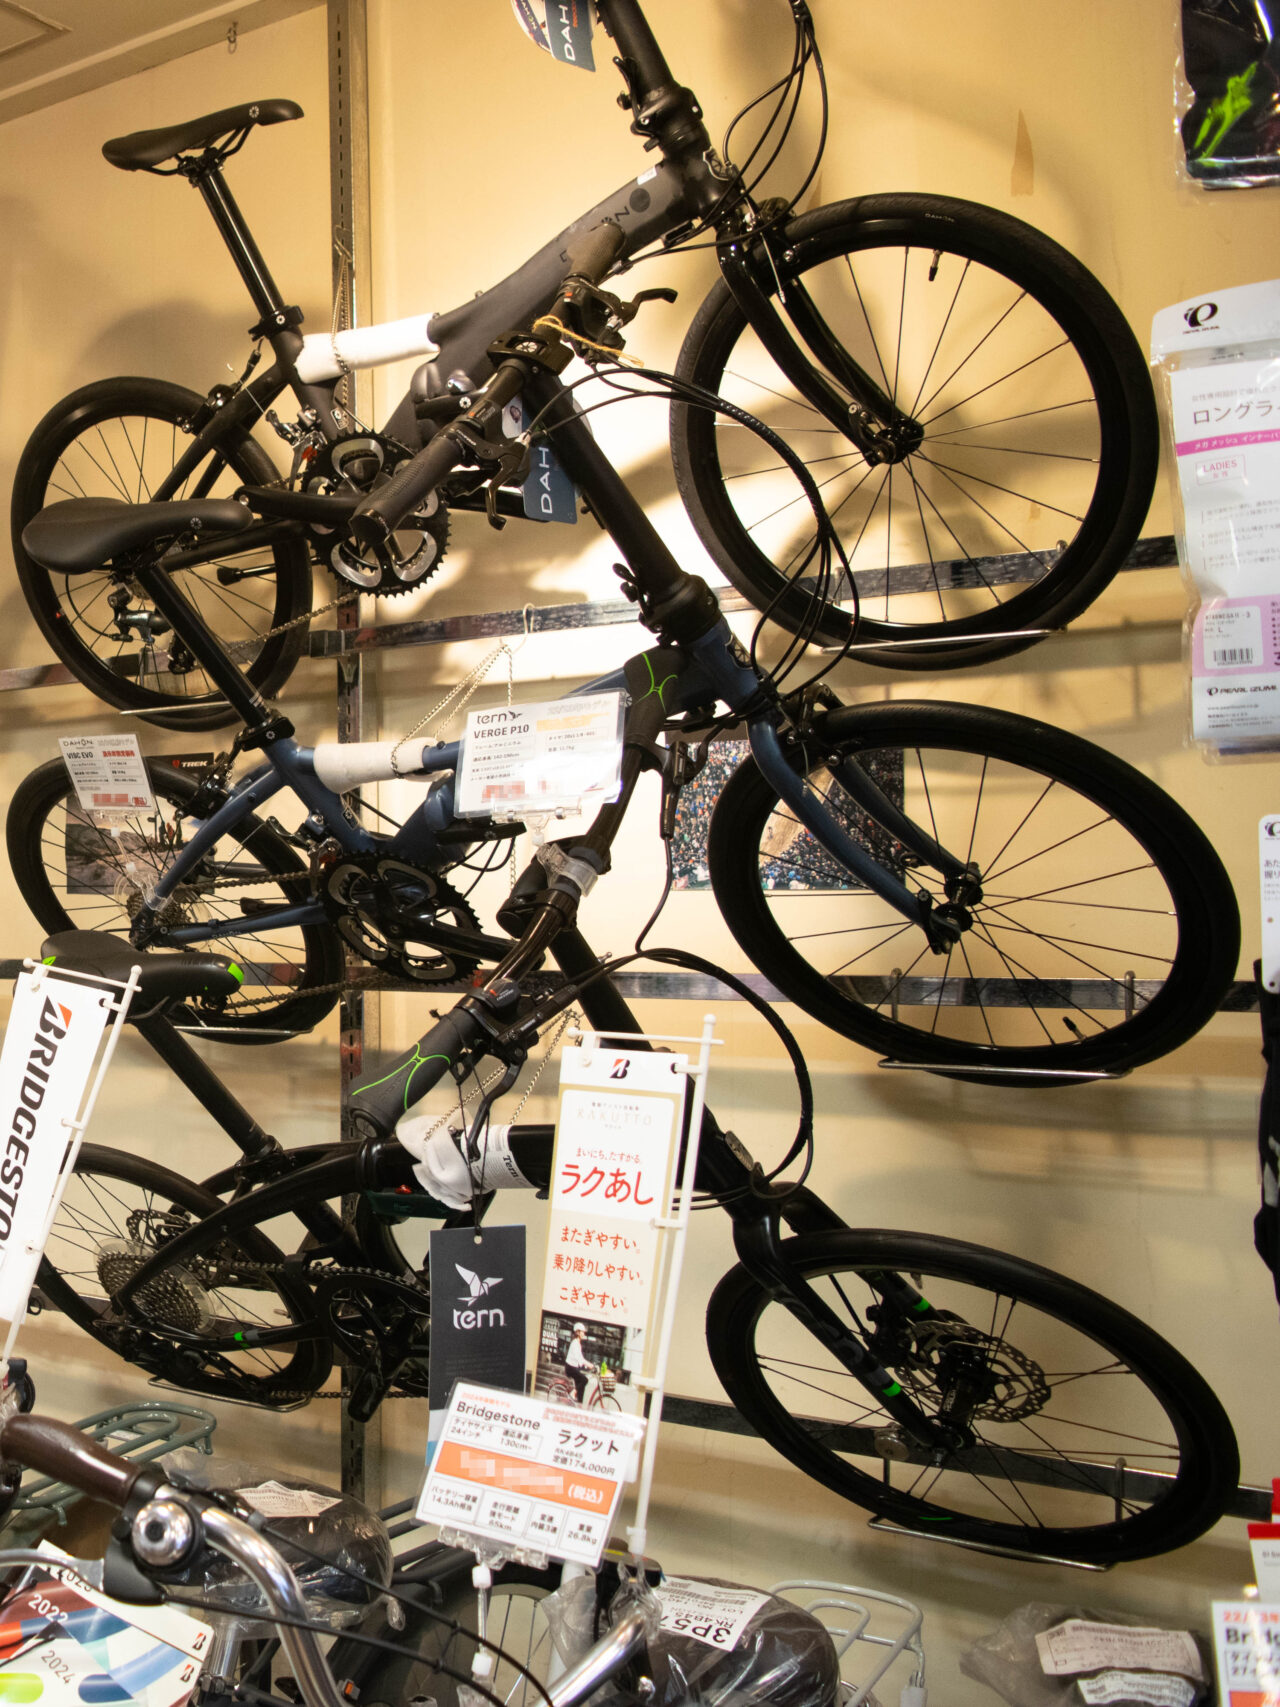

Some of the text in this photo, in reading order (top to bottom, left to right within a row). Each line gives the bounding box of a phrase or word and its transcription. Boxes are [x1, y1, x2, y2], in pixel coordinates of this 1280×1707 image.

[1193, 400, 1280, 425] ロングラ
[1203, 460, 1238, 473] LADIES
[477, 711, 506, 725] tern
[474, 724, 529, 739] VERGE P10
[502, 1154, 520, 1179] Tern
[562, 1164, 653, 1205] ラクあし
[561, 1226, 641, 1254] またぎやすい。
[552, 1254, 644, 1286] 乗り降りしやすい。
[560, 1287, 629, 1314] こぎやすい。
[453, 1308, 505, 1330] tern
[457, 1401, 541, 1431] Bridgestone
[558, 1428, 620, 1456] ラクット
[553, 1453, 616, 1477] 定価174,000円
[431, 1486, 478, 1504] バッテリー容量
[568, 1483, 604, 1504] (税込)
[41, 1650, 76, 1685] 2024
